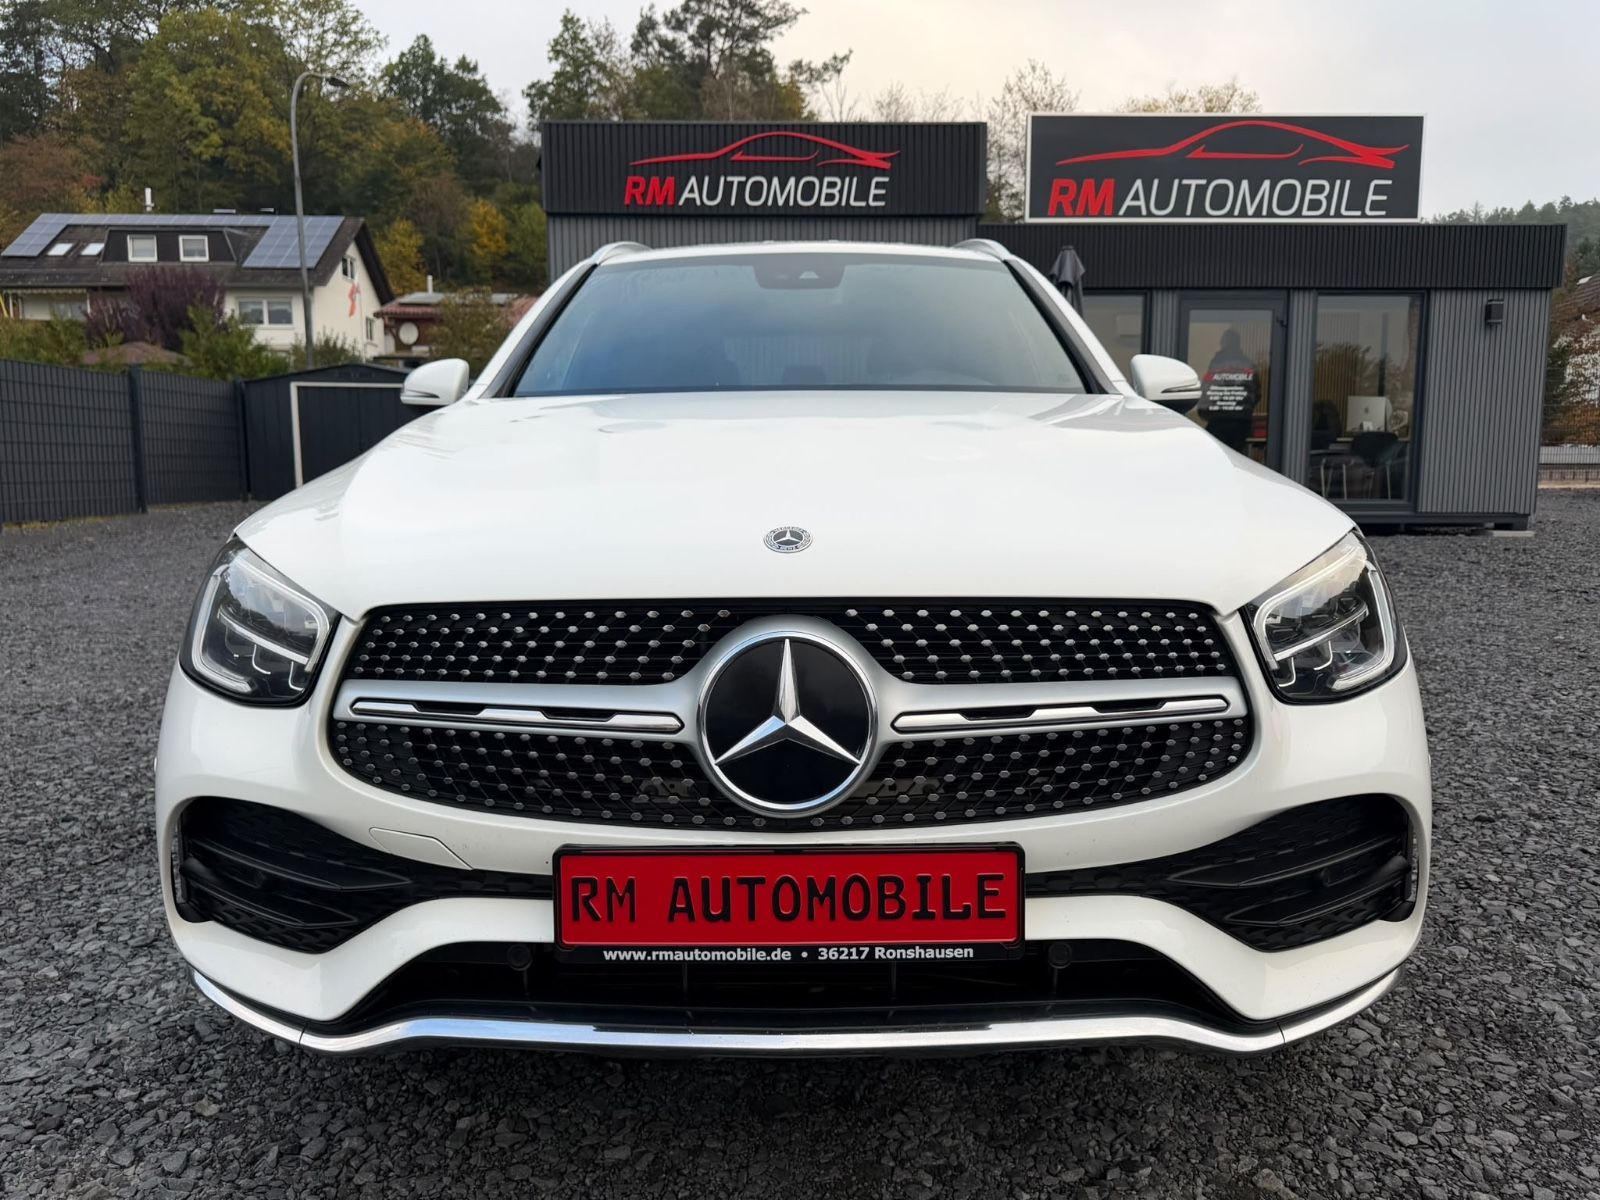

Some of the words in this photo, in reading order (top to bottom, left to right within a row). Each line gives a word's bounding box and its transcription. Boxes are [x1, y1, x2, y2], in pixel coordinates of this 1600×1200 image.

[623, 175, 676, 206] RM
[678, 175, 890, 207] AUTOMOBILE
[1047, 178, 1115, 216] RM
[1118, 178, 1393, 216] AUTOMOBILE
[570, 875, 637, 923] RM
[667, 873, 1007, 923] AUTOMOBILE
[602, 948, 792, 961] www.rmautomobile.de
[817, 946, 870, 960] 36217
[874, 945, 974, 959] Ronshausen
